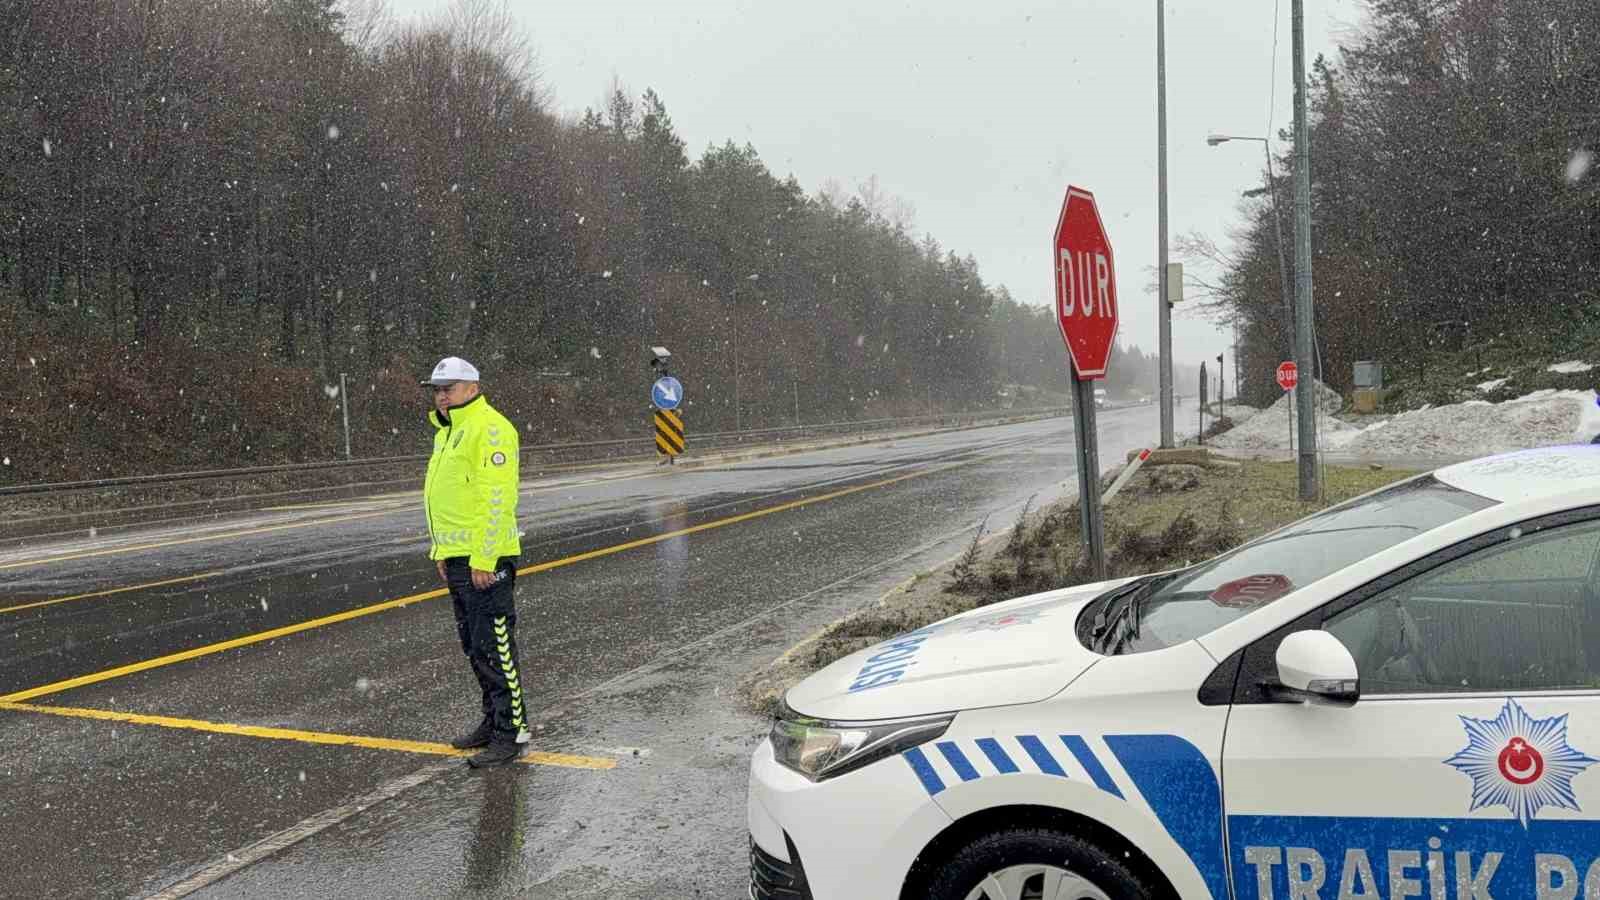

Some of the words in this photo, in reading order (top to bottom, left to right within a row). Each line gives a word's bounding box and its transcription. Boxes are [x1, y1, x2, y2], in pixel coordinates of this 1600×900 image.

[1061, 247, 1112, 318] DUR
[1278, 369, 1297, 381] DUR
[1244, 836, 1504, 900] TRAFİK
